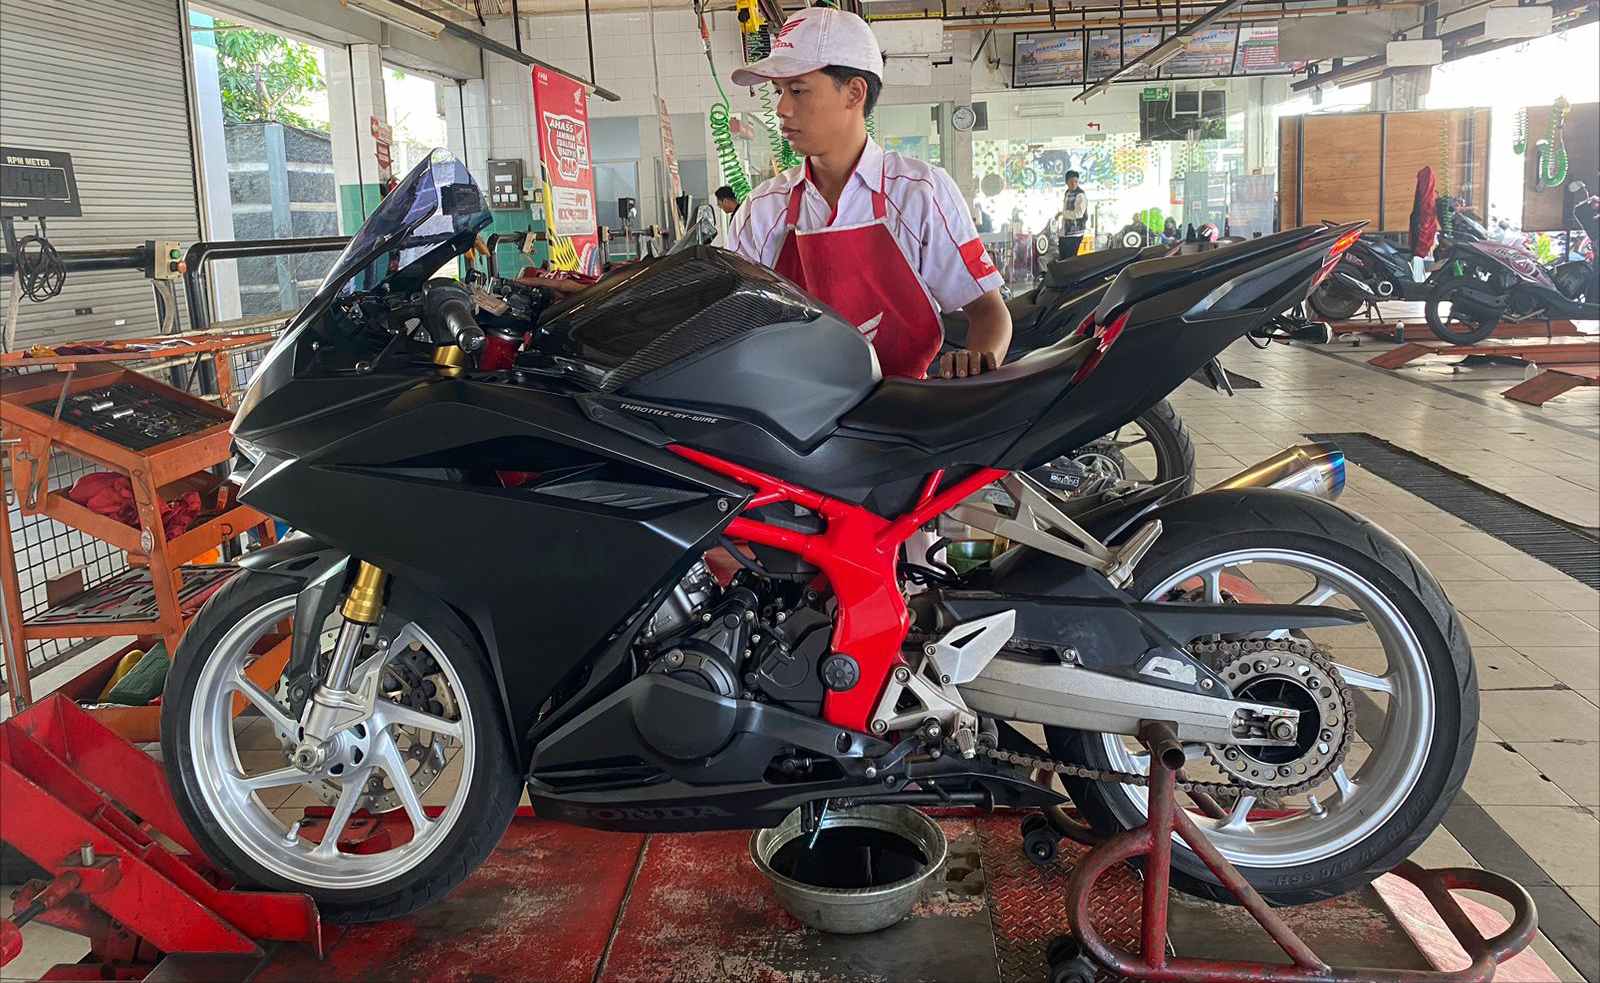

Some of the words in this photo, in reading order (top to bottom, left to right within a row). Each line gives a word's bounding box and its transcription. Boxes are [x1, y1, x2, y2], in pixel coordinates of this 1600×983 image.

[7, 156, 24, 165] RPM
[25, 158, 50, 167] METER
[620, 403, 718, 424] THROTTLE-BY-WIRE
